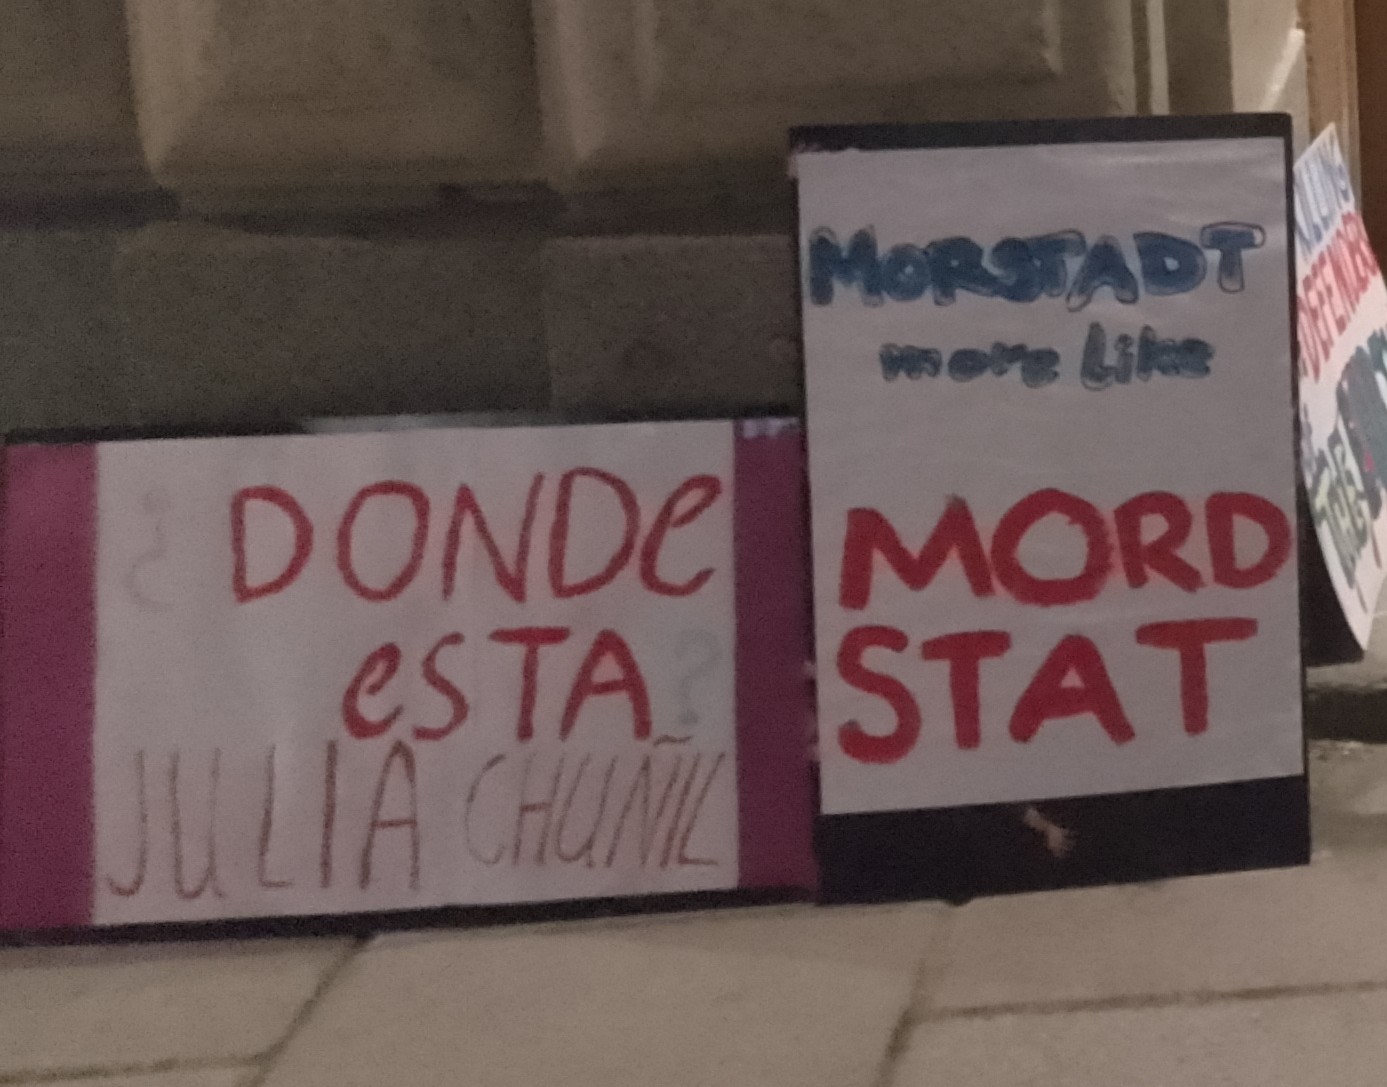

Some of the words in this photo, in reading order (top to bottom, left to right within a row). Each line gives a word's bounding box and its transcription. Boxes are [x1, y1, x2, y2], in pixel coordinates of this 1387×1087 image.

[808, 220, 1267, 312] MORSTADT
[878, 340, 1064, 390] more
[838, 486, 1292, 612] MORD
[836, 617, 1259, 765] STAT
[106, 738, 420, 900] JULIA
[464, 734, 727, 869] CHUÑIL
